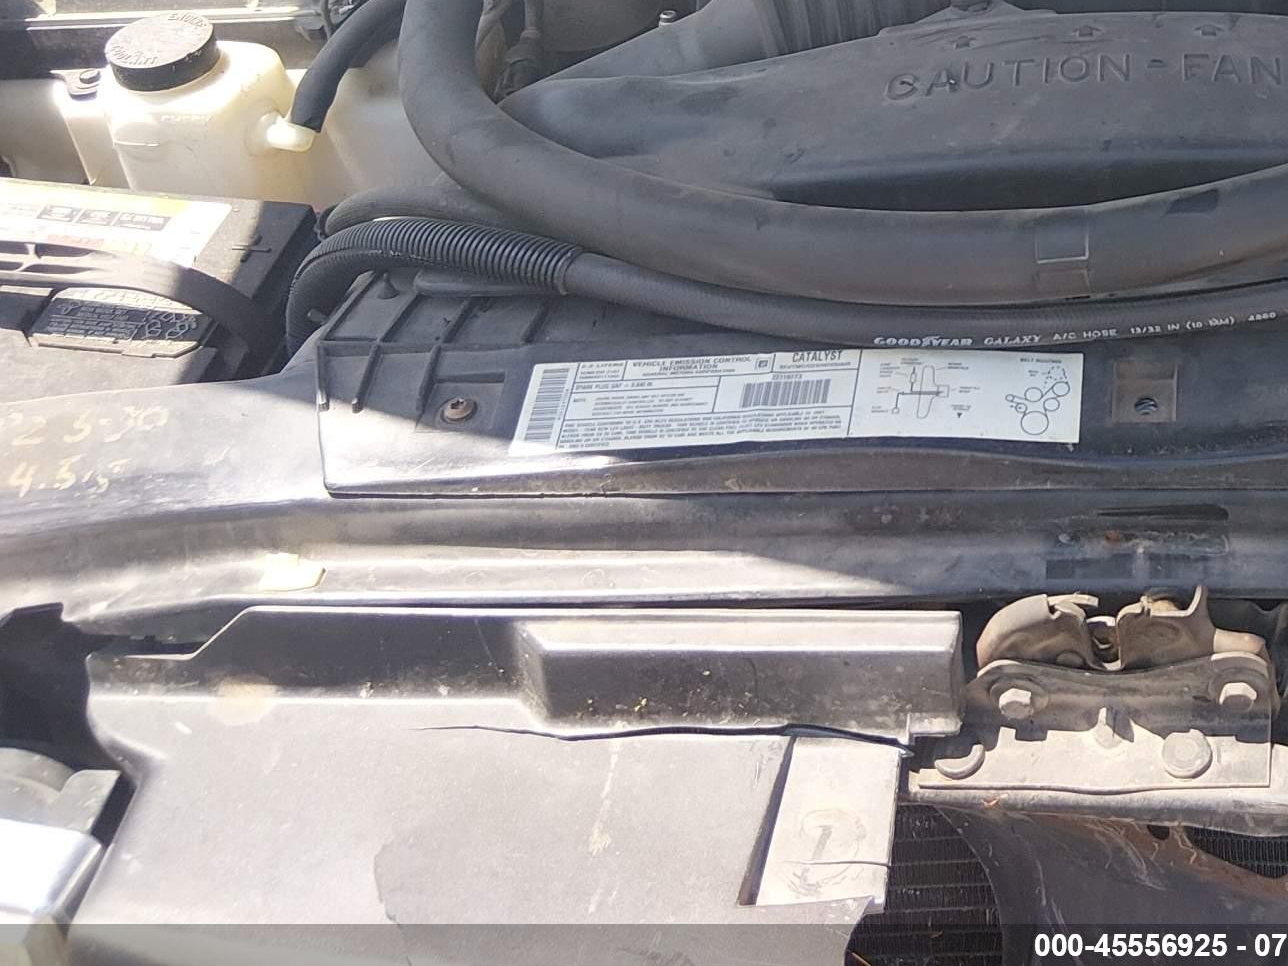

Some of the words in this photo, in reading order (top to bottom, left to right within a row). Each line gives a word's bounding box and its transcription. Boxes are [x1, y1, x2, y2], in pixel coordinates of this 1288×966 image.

[884, 53, 1131, 101] CAUTION
[1181, 53, 1283, 86] FAN
[873, 336, 973, 347] GOODYEAR
[984, 334, 1042, 346] GALAXY
[1053, 331, 1077, 340] A/C
[713, 356, 752, 364] CONTROL
[792, 350, 843, 363] CATALYST
[659, 364, 718, 372] INFORMATION
